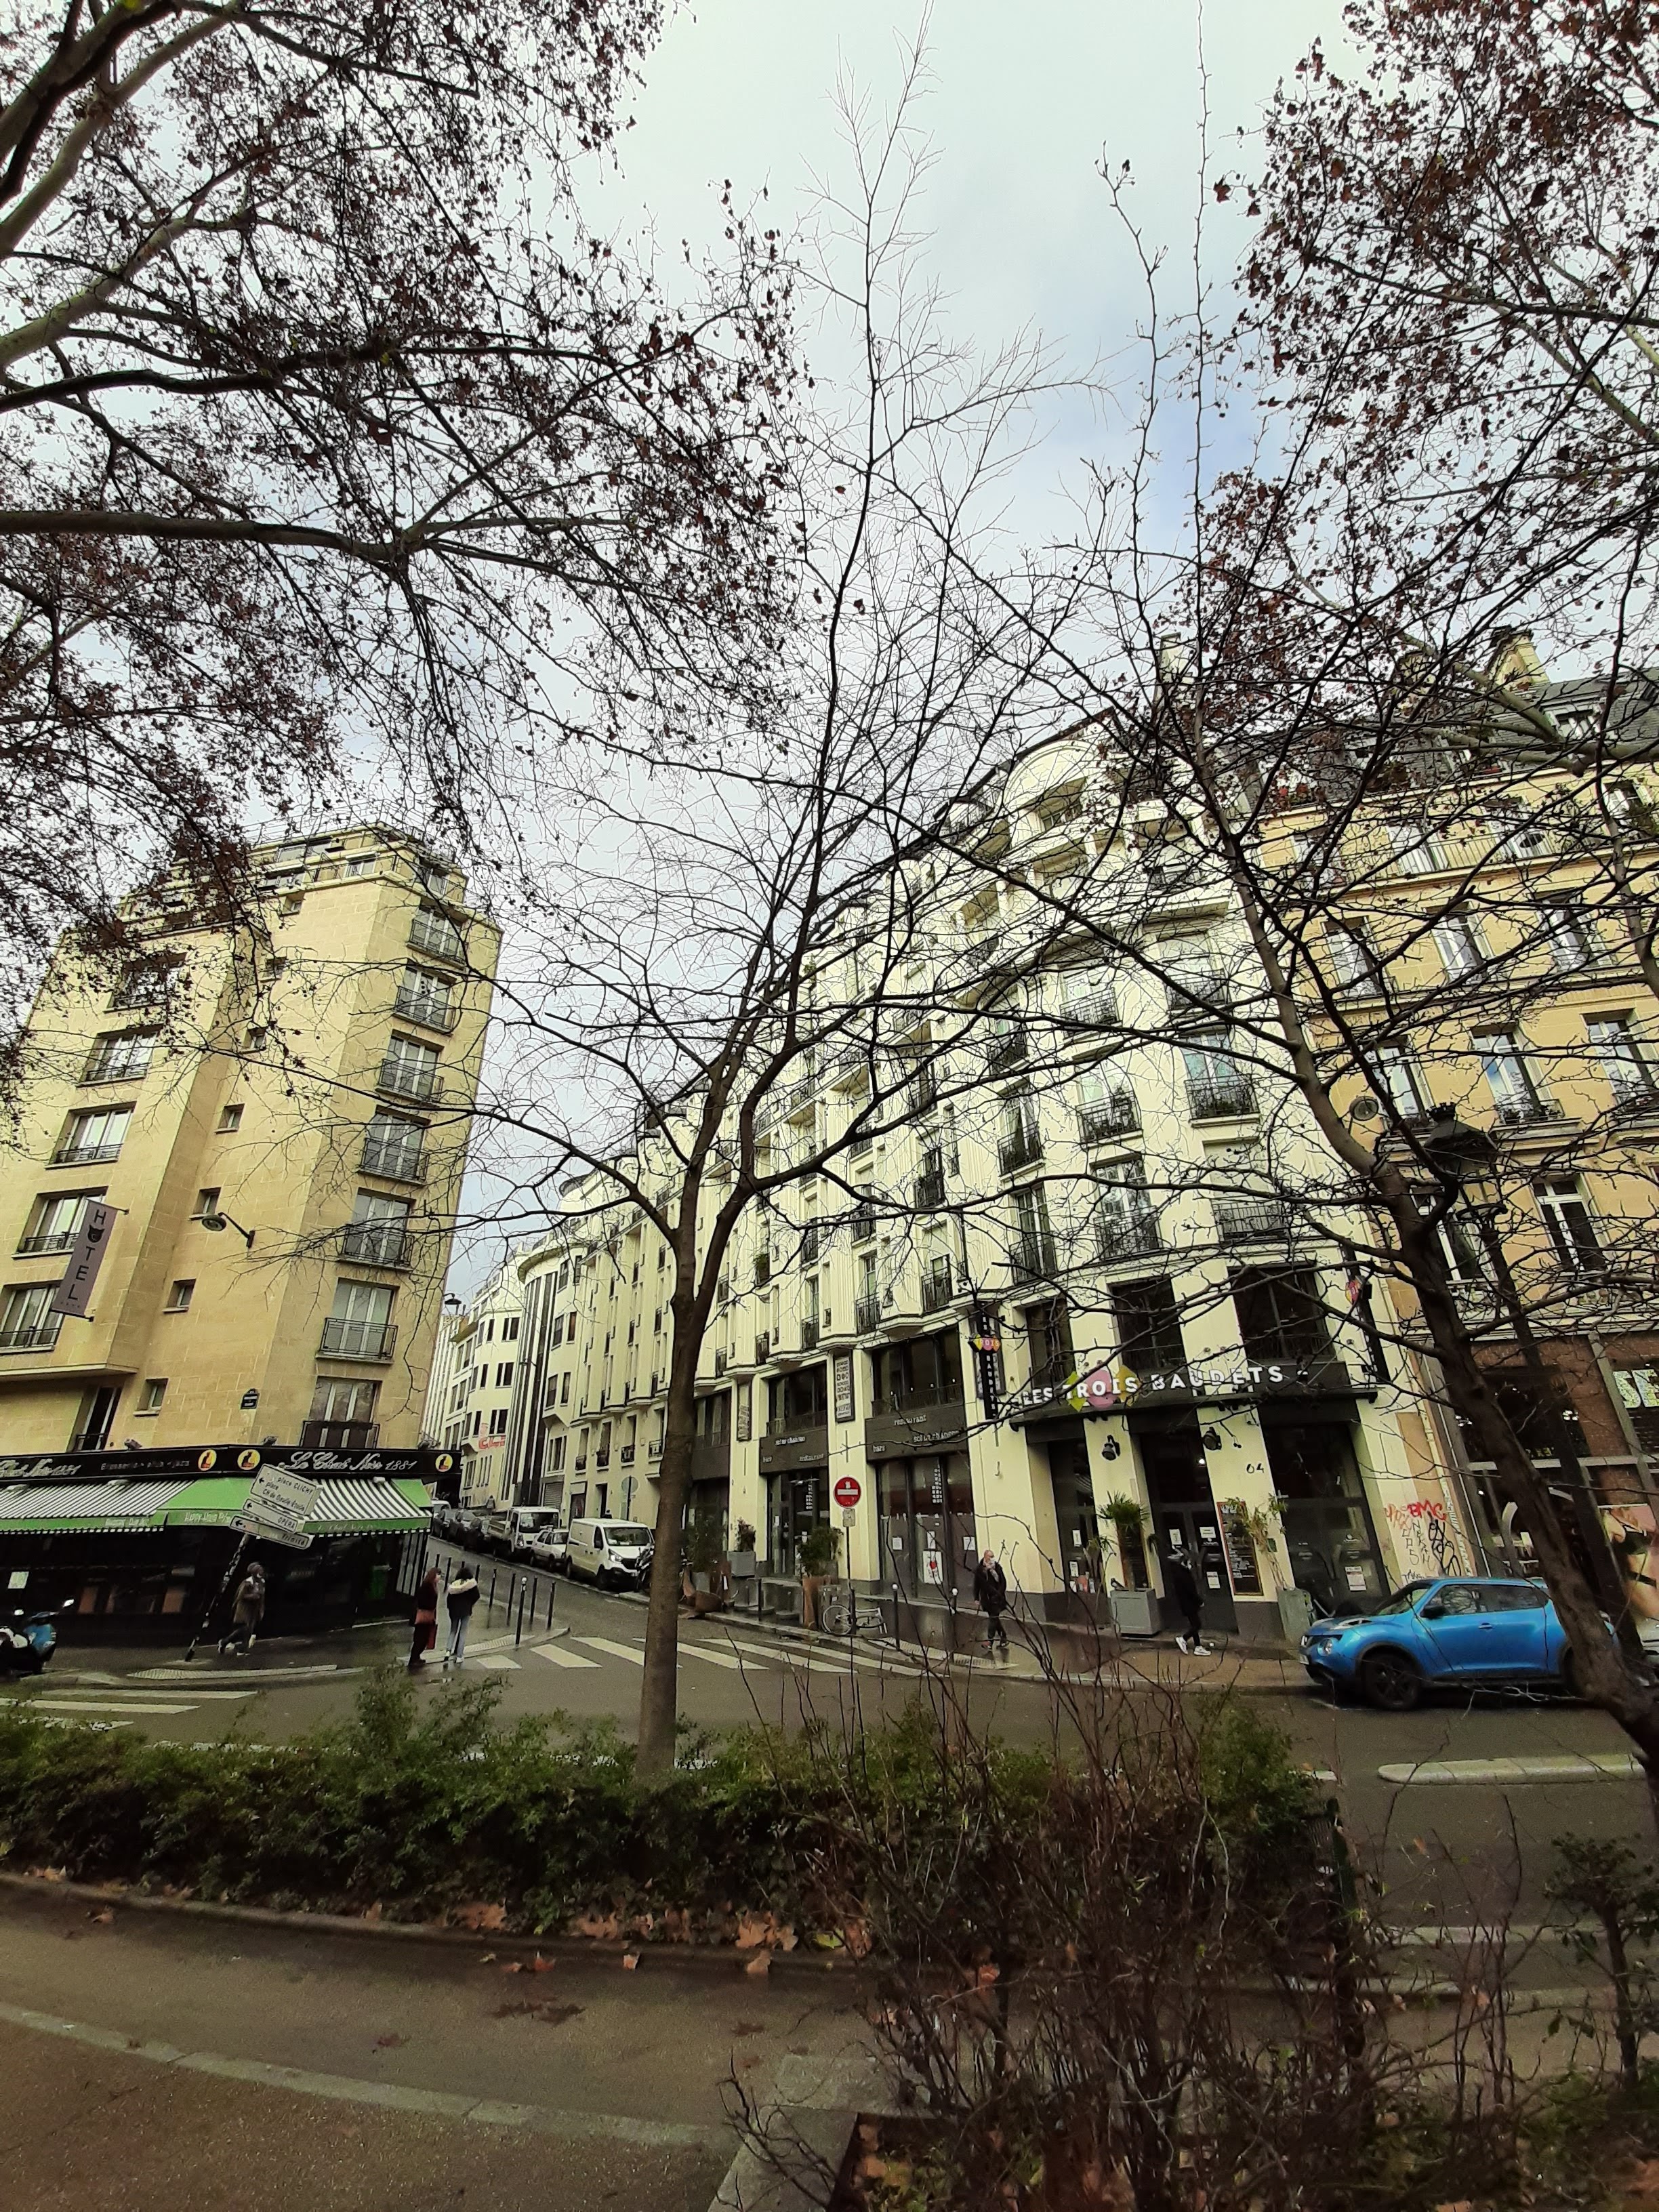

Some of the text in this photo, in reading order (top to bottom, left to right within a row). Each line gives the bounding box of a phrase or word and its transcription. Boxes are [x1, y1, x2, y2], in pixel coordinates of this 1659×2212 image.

[1022, 1387, 1053, 1406] LES
[1150, 1366, 1284, 1391] BAUDETS
[312, 1452, 352, 1470] Chat
[349, 1453, 383, 1471] Noir
[384, 1460, 417, 1471] 1881
